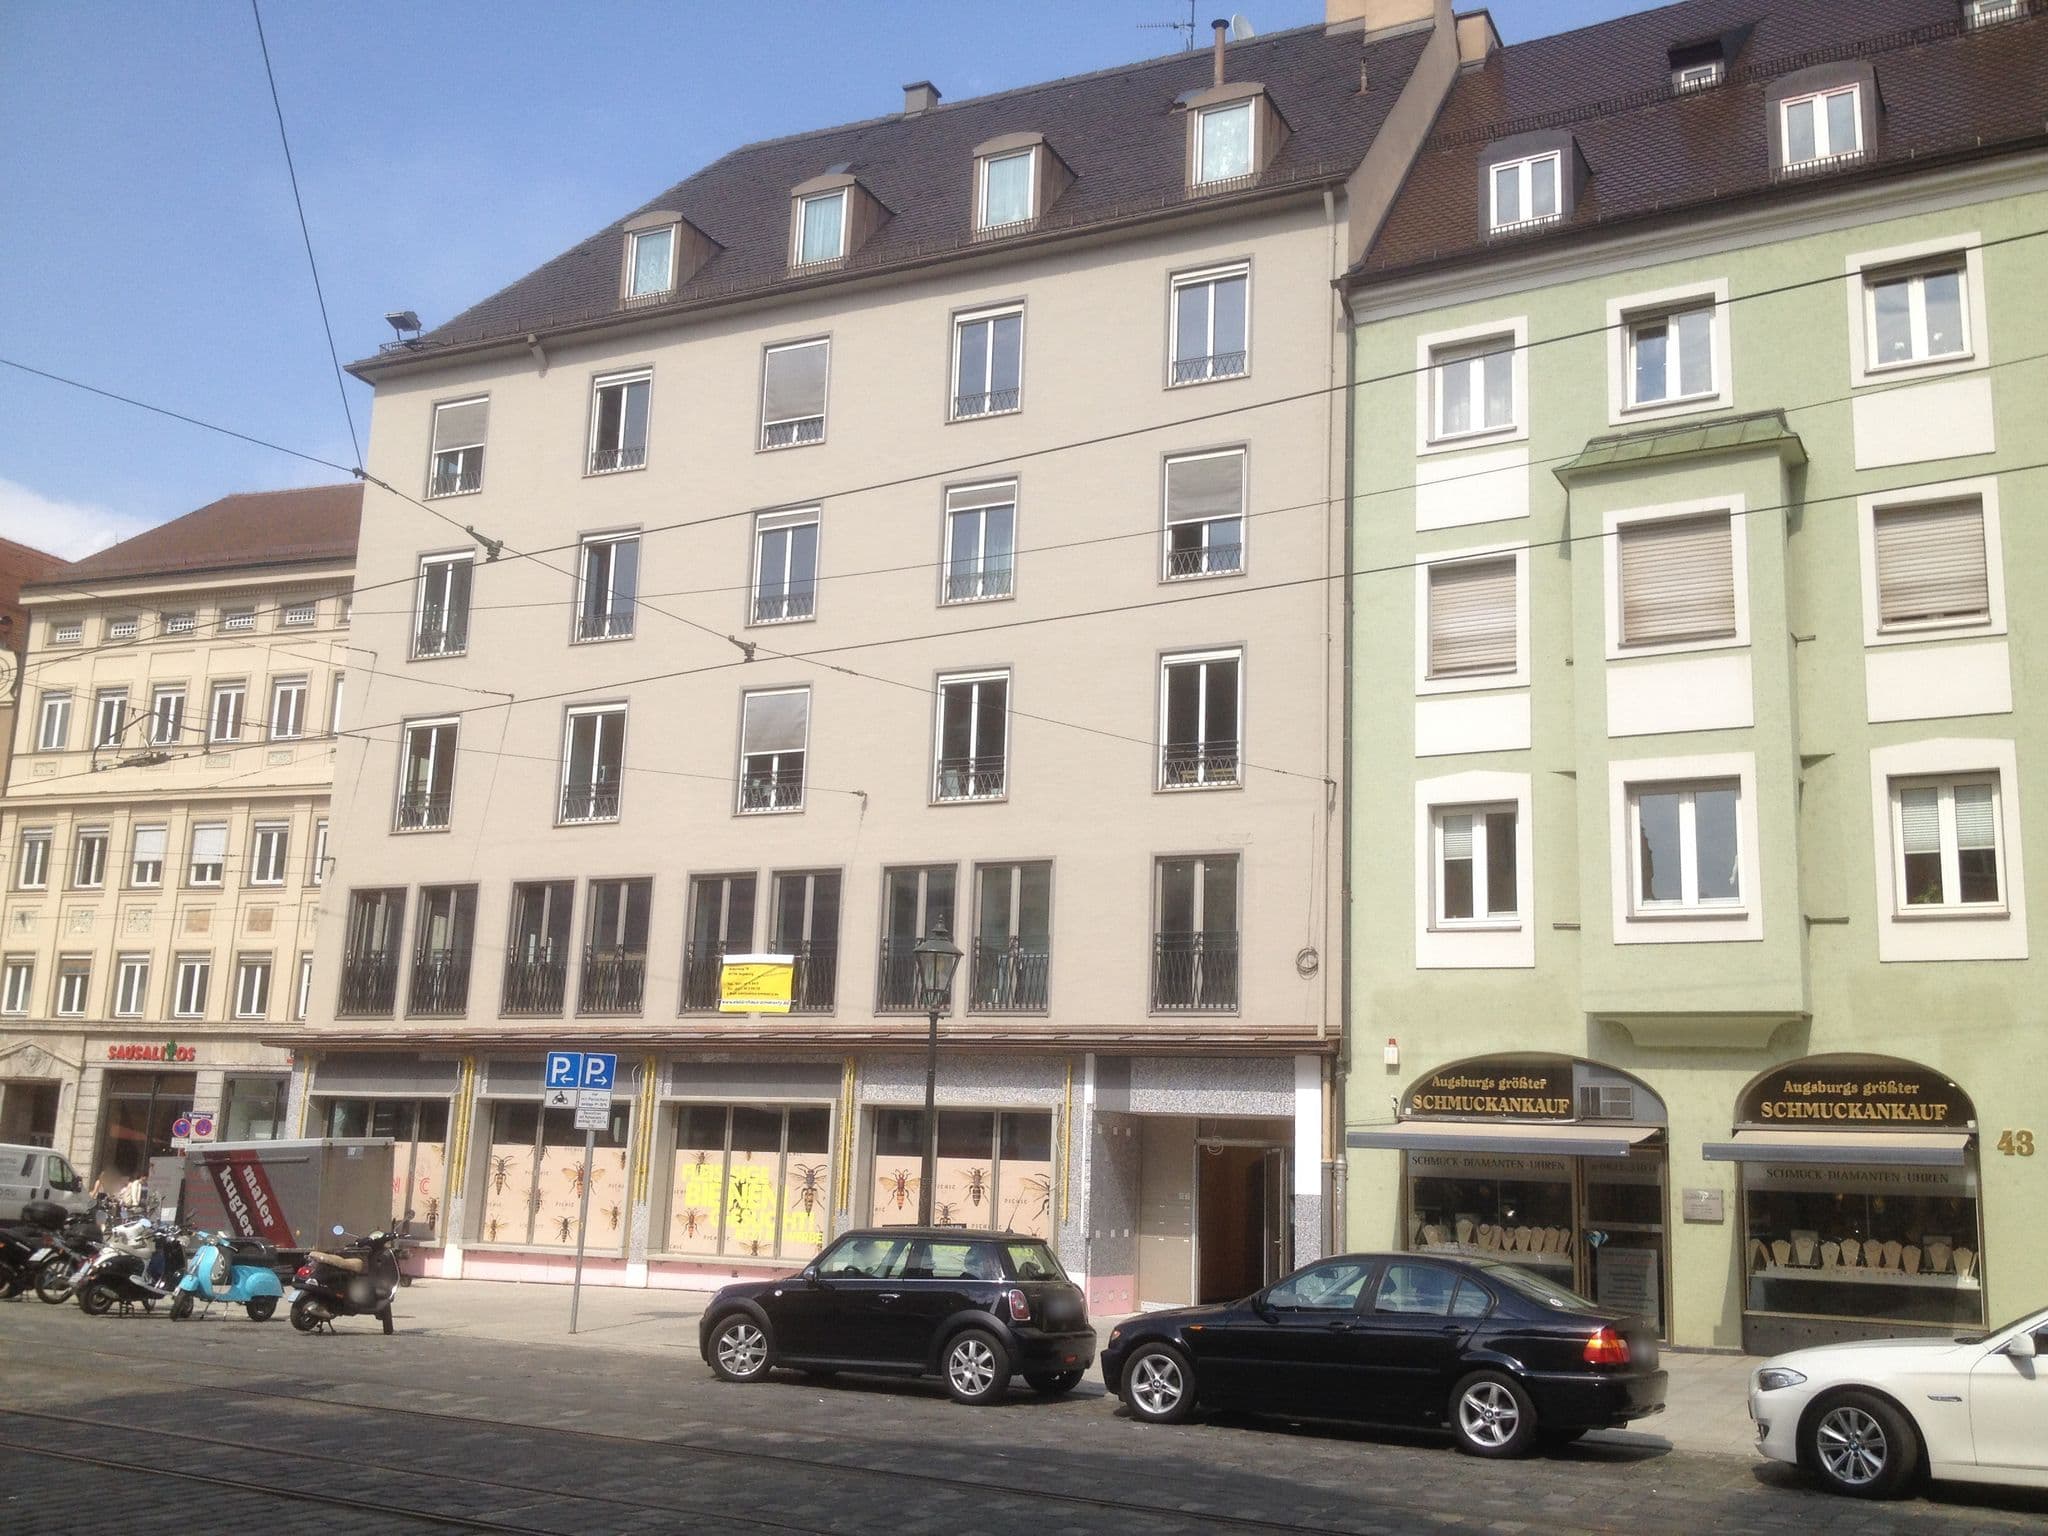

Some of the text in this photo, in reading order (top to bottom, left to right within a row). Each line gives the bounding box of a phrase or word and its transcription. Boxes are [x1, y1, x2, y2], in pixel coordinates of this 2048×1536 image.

[551, 1057, 571, 1084] P
[585, 1058, 606, 1085] P
[1432, 1076, 1547, 1091] Augsburgs größter
[1783, 1080, 1920, 1096] Augsburgs größter
[1412, 1095, 1569, 1114] SCHMUCKANKAUF
[1761, 1102, 1948, 1121] SCHMUCKANKAUF
[1997, 1130, 2035, 1156] 43
[1766, 1168, 1825, 1180] SCHMUCK
[219, 1165, 255, 1237] kugler
[242, 1165, 274, 1227] maler
